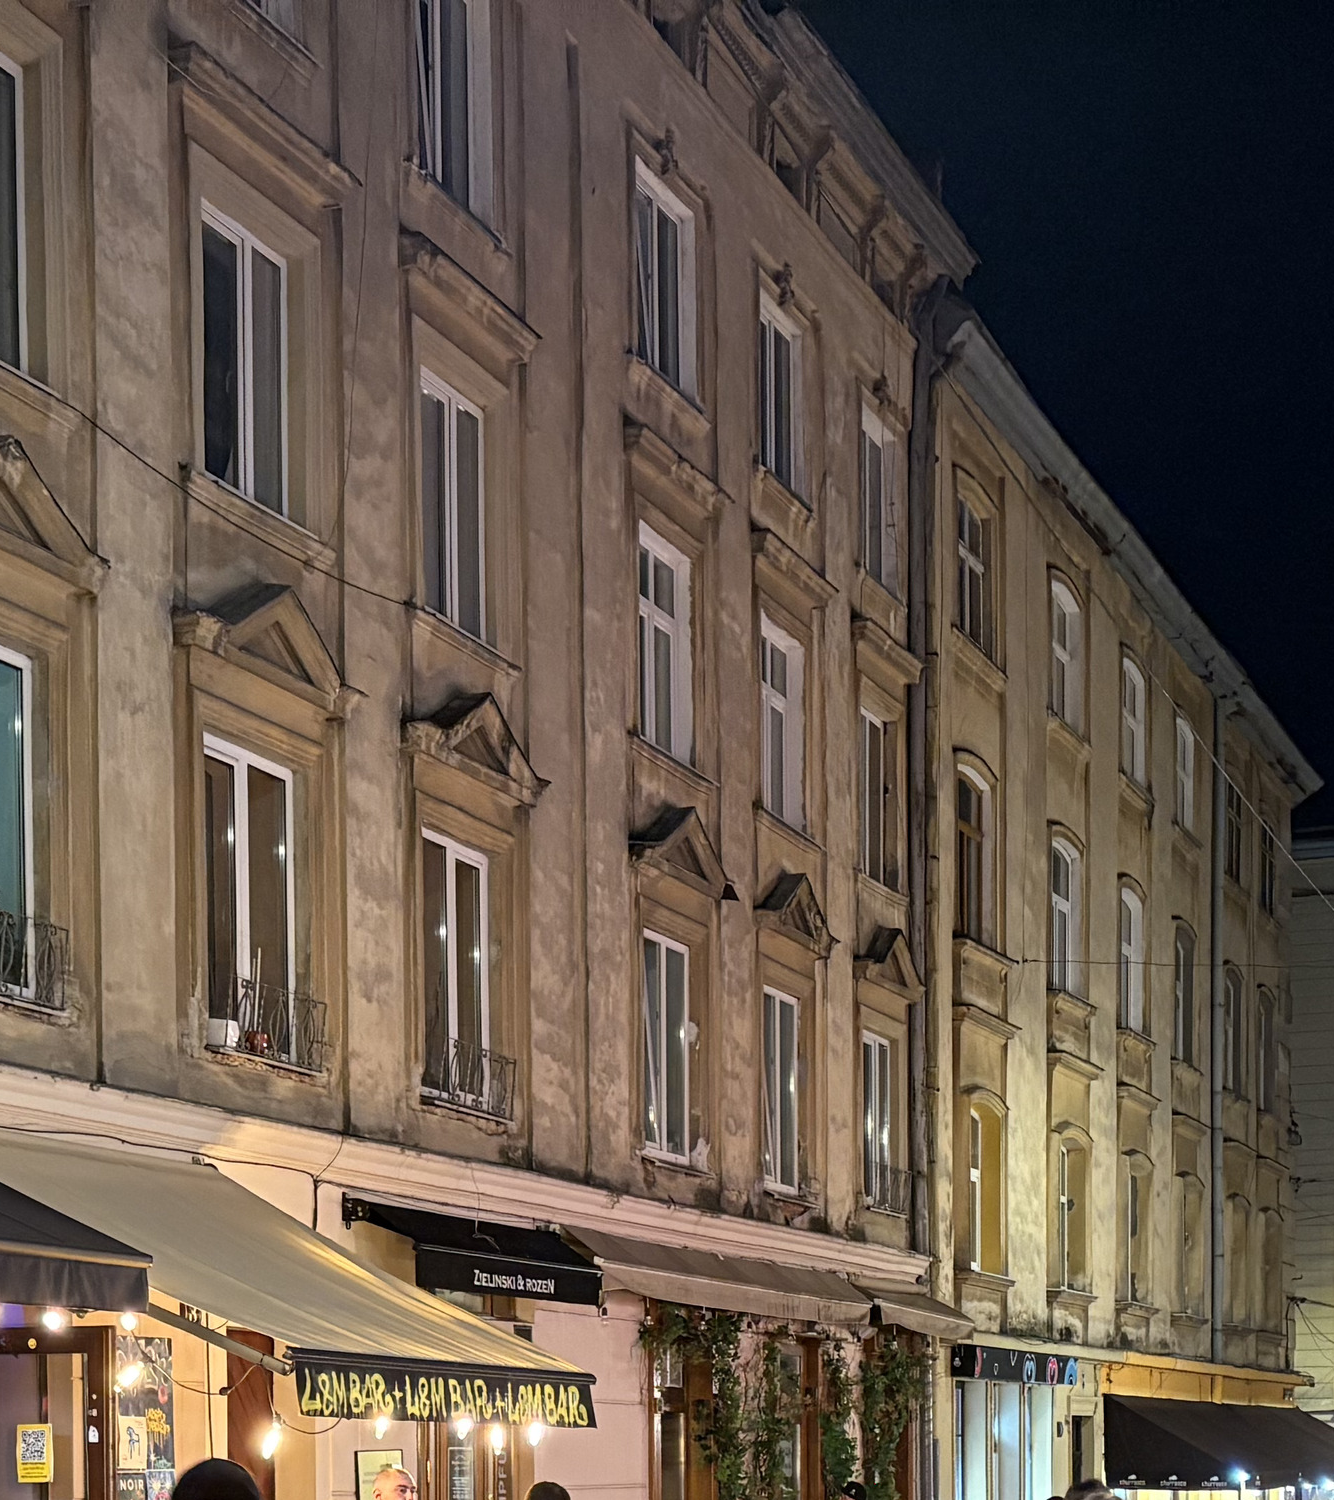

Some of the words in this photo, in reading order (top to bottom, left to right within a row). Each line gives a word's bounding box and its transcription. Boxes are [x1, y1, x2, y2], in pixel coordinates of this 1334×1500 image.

[473, 1269, 516, 1290] ZIELINSKI
[517, 1274, 525, 1290] &
[525, 1278, 555, 1295] ROZEN
[349, 1371, 394, 1417] BAR
[449, 1378, 494, 1421] BAR
[544, 1384, 588, 1426] BAR
[119, 1479, 145, 1491] NOIR
